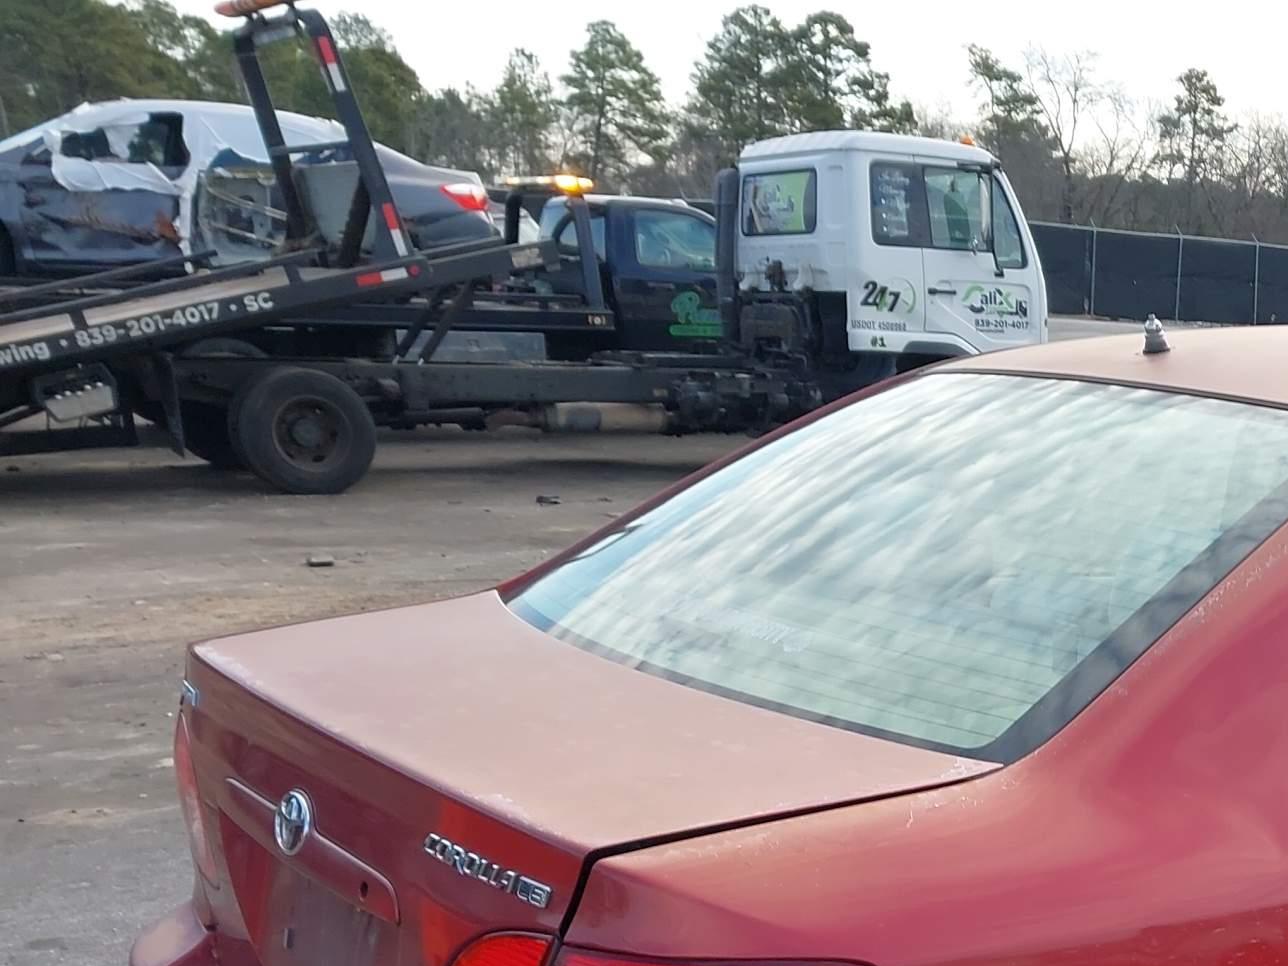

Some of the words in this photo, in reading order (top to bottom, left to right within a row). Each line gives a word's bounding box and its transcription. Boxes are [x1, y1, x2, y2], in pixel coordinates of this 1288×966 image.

[75, 302, 220, 348] 839-201-4017
[243, 291, 275, 313] SC
[424, 832, 516, 894] COROLLA
